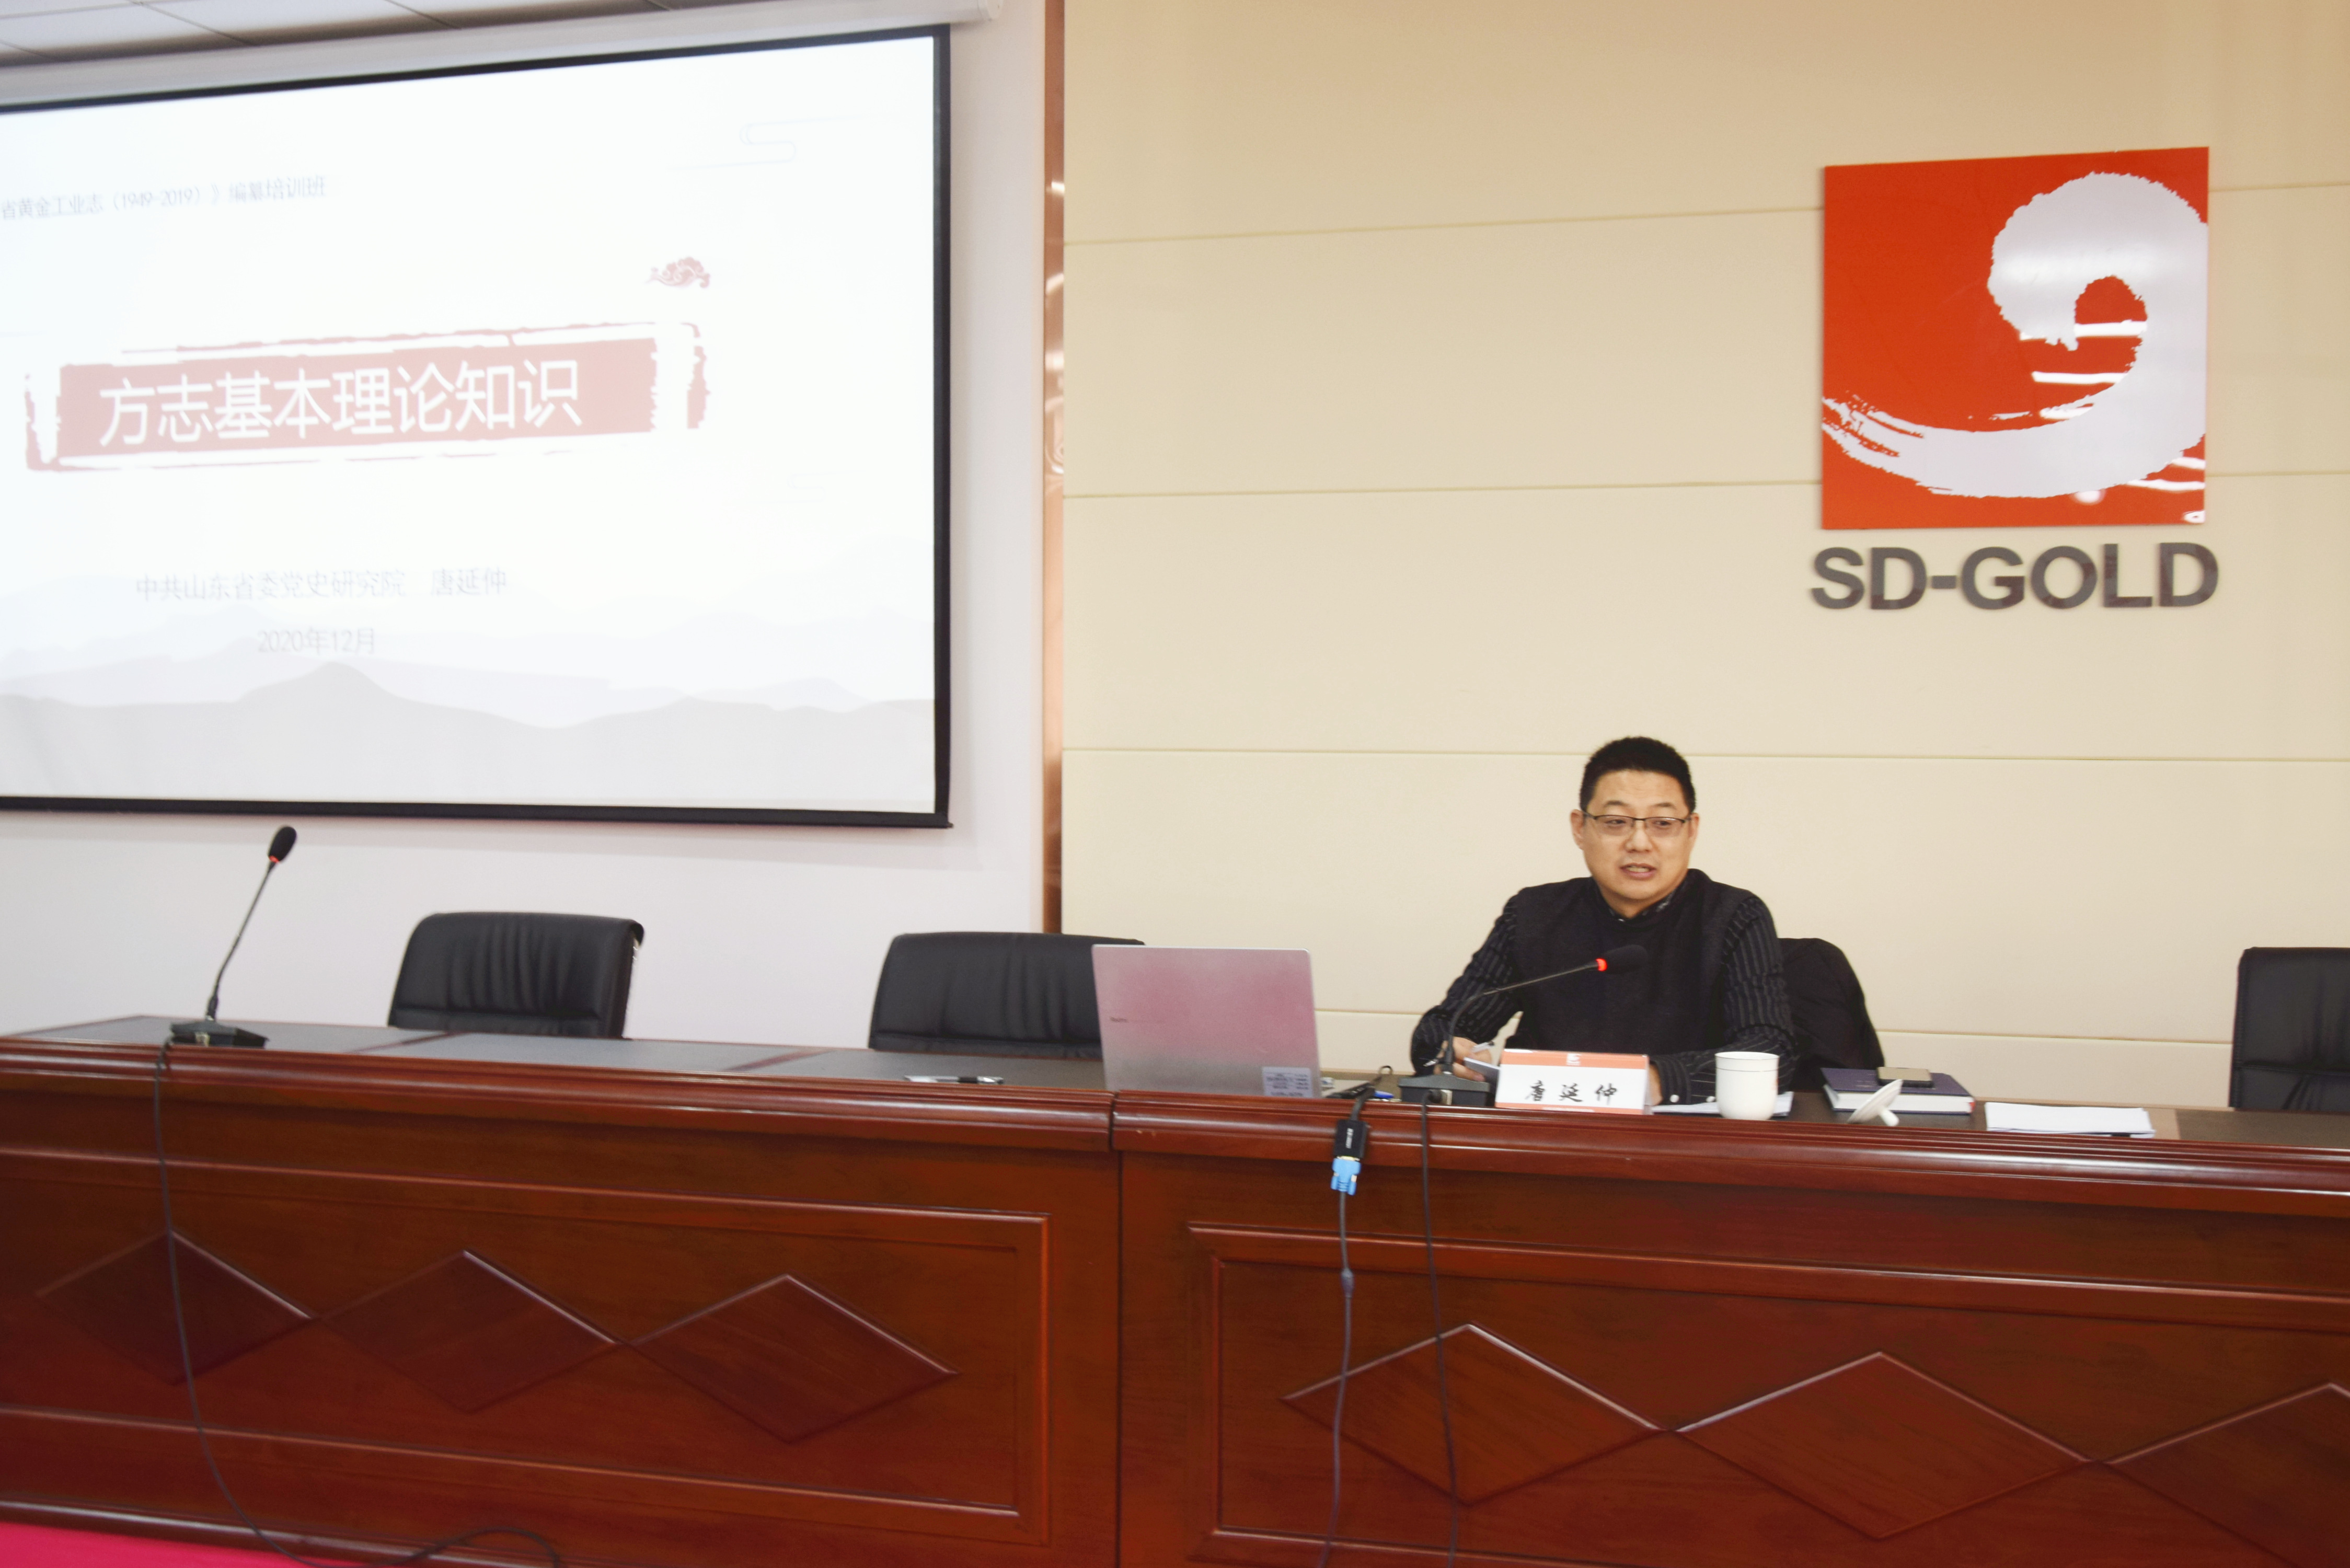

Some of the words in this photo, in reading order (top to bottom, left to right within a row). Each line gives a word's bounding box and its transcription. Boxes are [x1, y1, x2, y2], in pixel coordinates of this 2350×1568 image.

[100, 360, 582, 446] 方志基本理论知识
[136, 569, 406, 601] 中共山东省委党史研究院
[430, 566, 507, 597] 唐延仲
[1811, 542, 2219, 610] SD-GOLD
[257, 627, 376, 655] 2020年12月
[1525, 1080, 1618, 1105] 唐延仲
